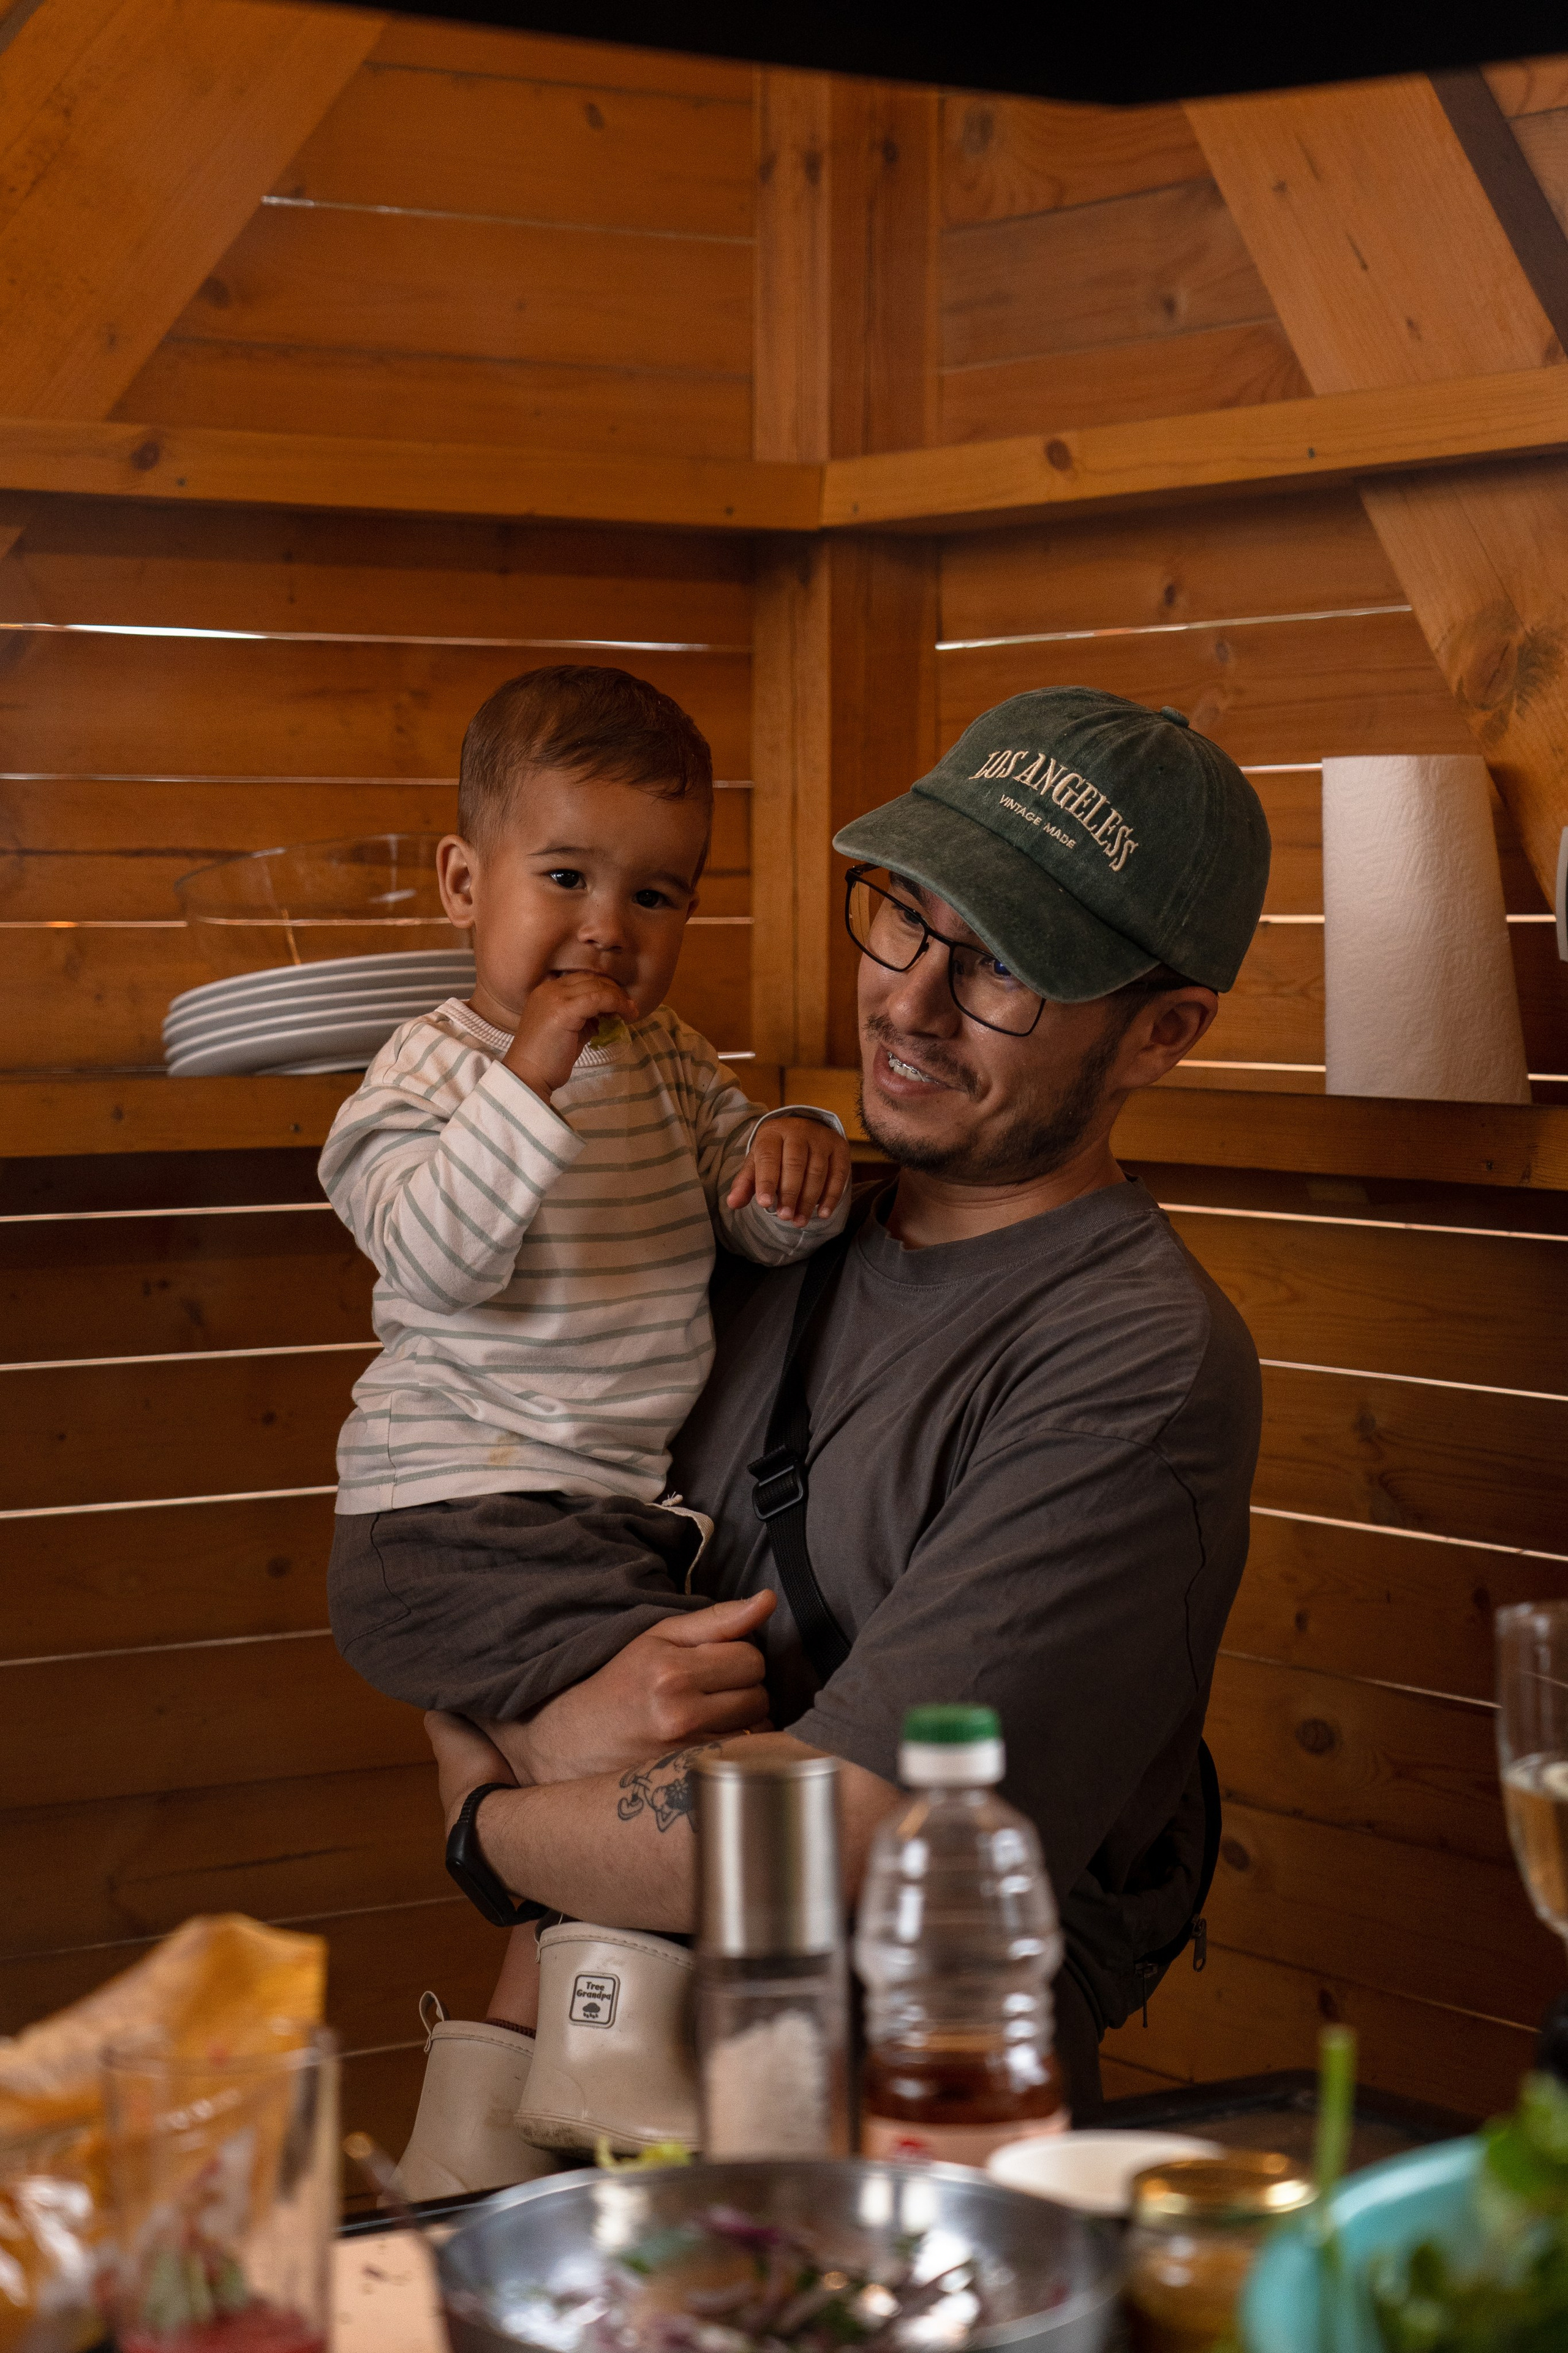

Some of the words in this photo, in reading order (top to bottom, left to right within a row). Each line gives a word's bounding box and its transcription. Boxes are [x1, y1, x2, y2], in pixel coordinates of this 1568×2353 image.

[968, 750, 1029, 780] LOS
[1012, 753, 1139, 872] ANGELESS
[999, 794, 1042, 826] VINTAGE
[1043, 822, 1077, 849] MADE
[576, 1989, 611, 2001] Grandpa
[586, 1981, 605, 1991] Tree
